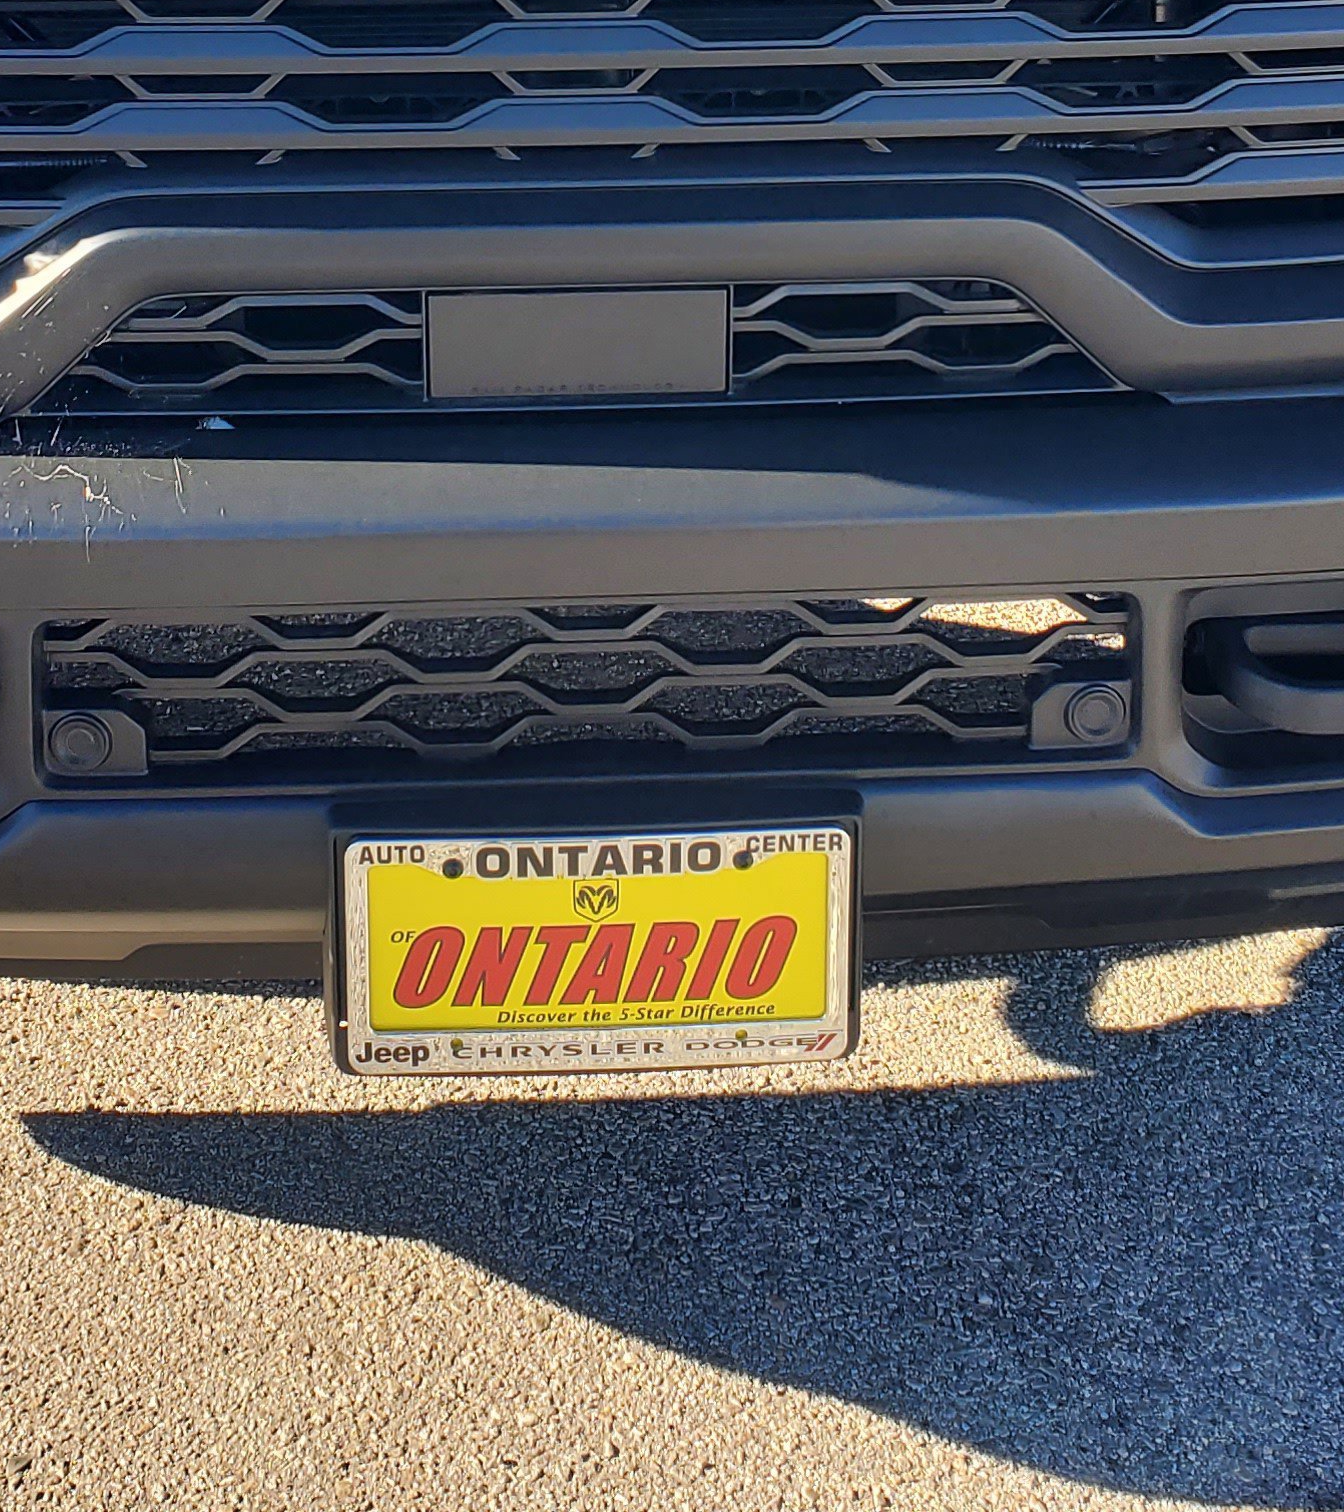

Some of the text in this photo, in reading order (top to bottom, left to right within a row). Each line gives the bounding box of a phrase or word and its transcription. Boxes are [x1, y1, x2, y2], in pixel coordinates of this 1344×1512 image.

[359, 833, 843, 878] AUTO ONTARIO CENTER
[391, 915, 798, 1008] OF ONTARIO
[497, 1003, 775, 1023] Discover the 5-Star Difference
[356, 1036, 818, 1066] Jeep CHRYSLER DODGE
